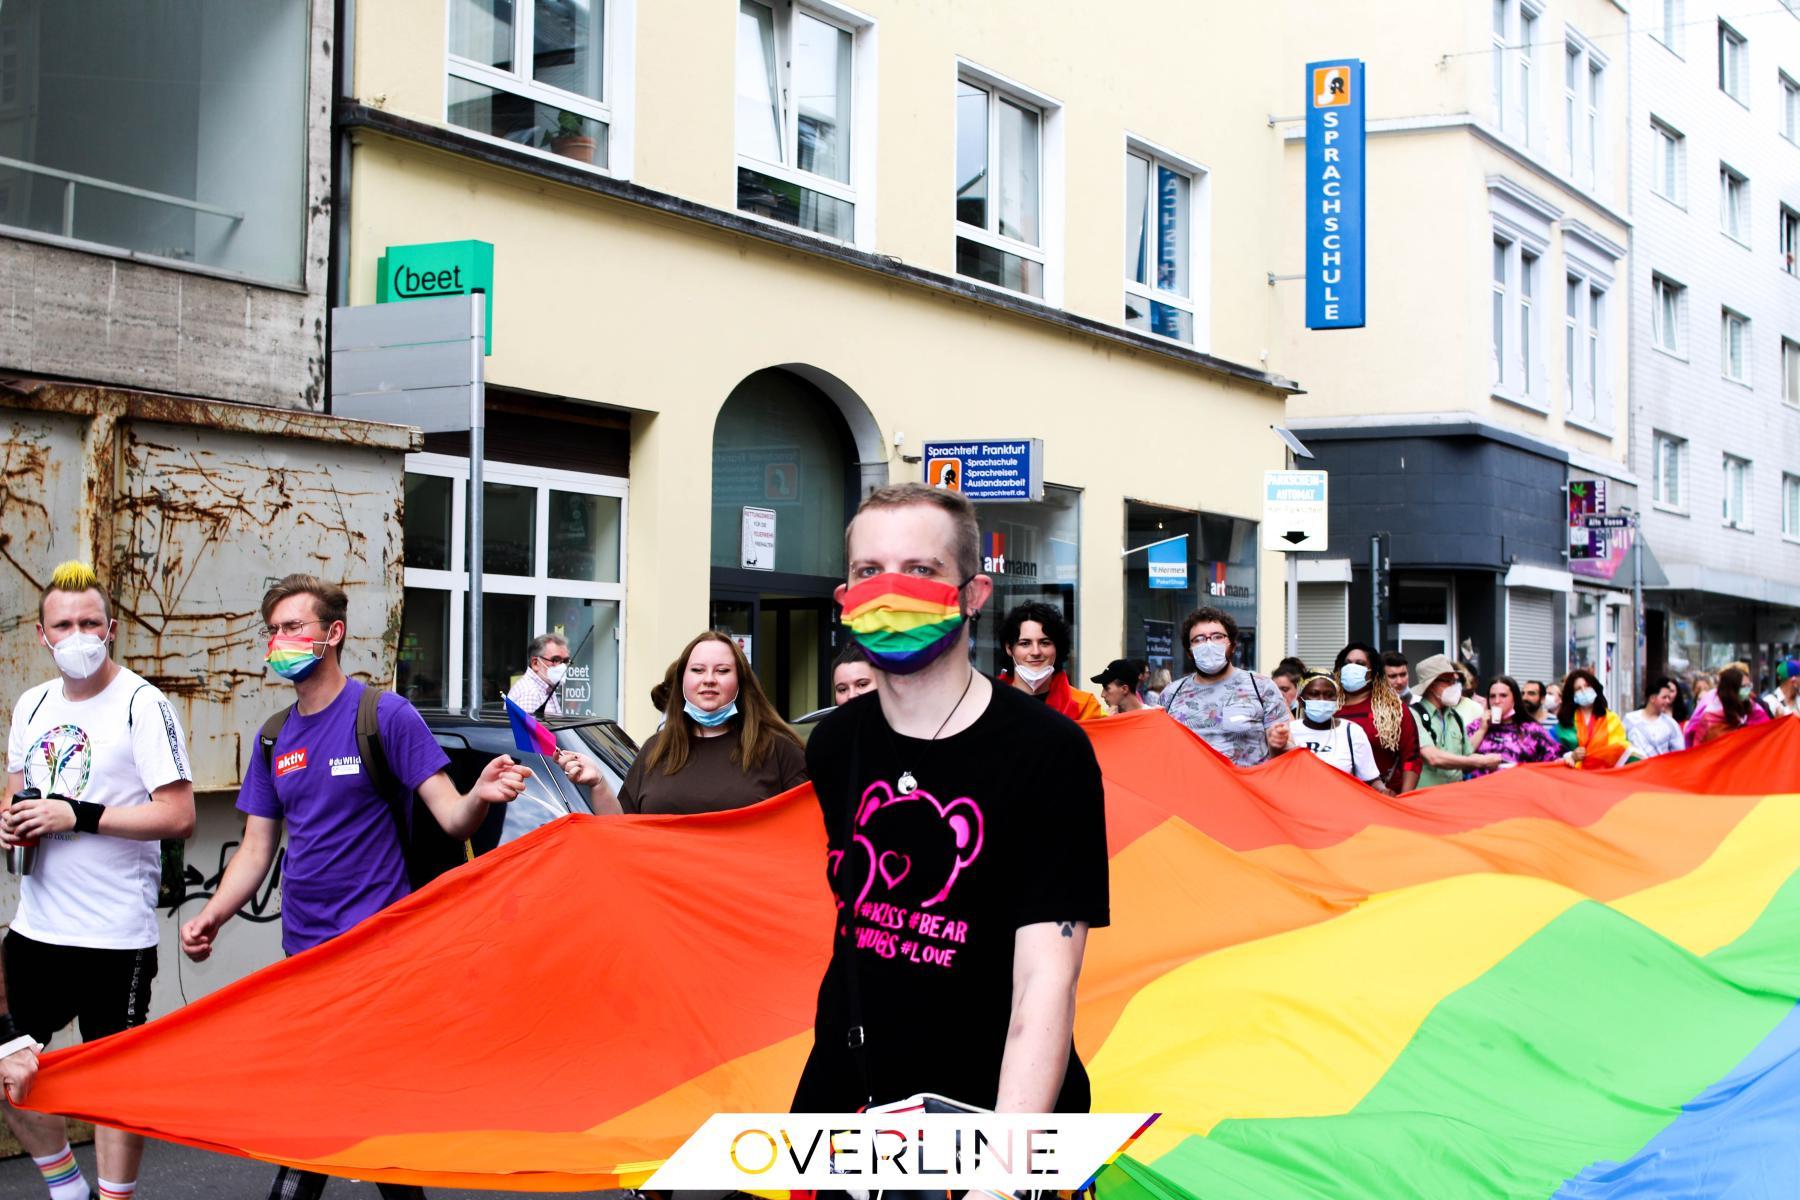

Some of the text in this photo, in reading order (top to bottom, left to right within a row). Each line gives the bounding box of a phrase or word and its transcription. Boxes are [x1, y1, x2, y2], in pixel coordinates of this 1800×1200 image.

[1322, 112, 1341, 321] SPRACHSCHULE
[928, 444, 1025, 457] Sprachtreff Frankfurt
[278, 752, 305, 769] aktiv
[909, 912, 968, 943] #BEAR
[901, 941, 957, 967] #LOVE
